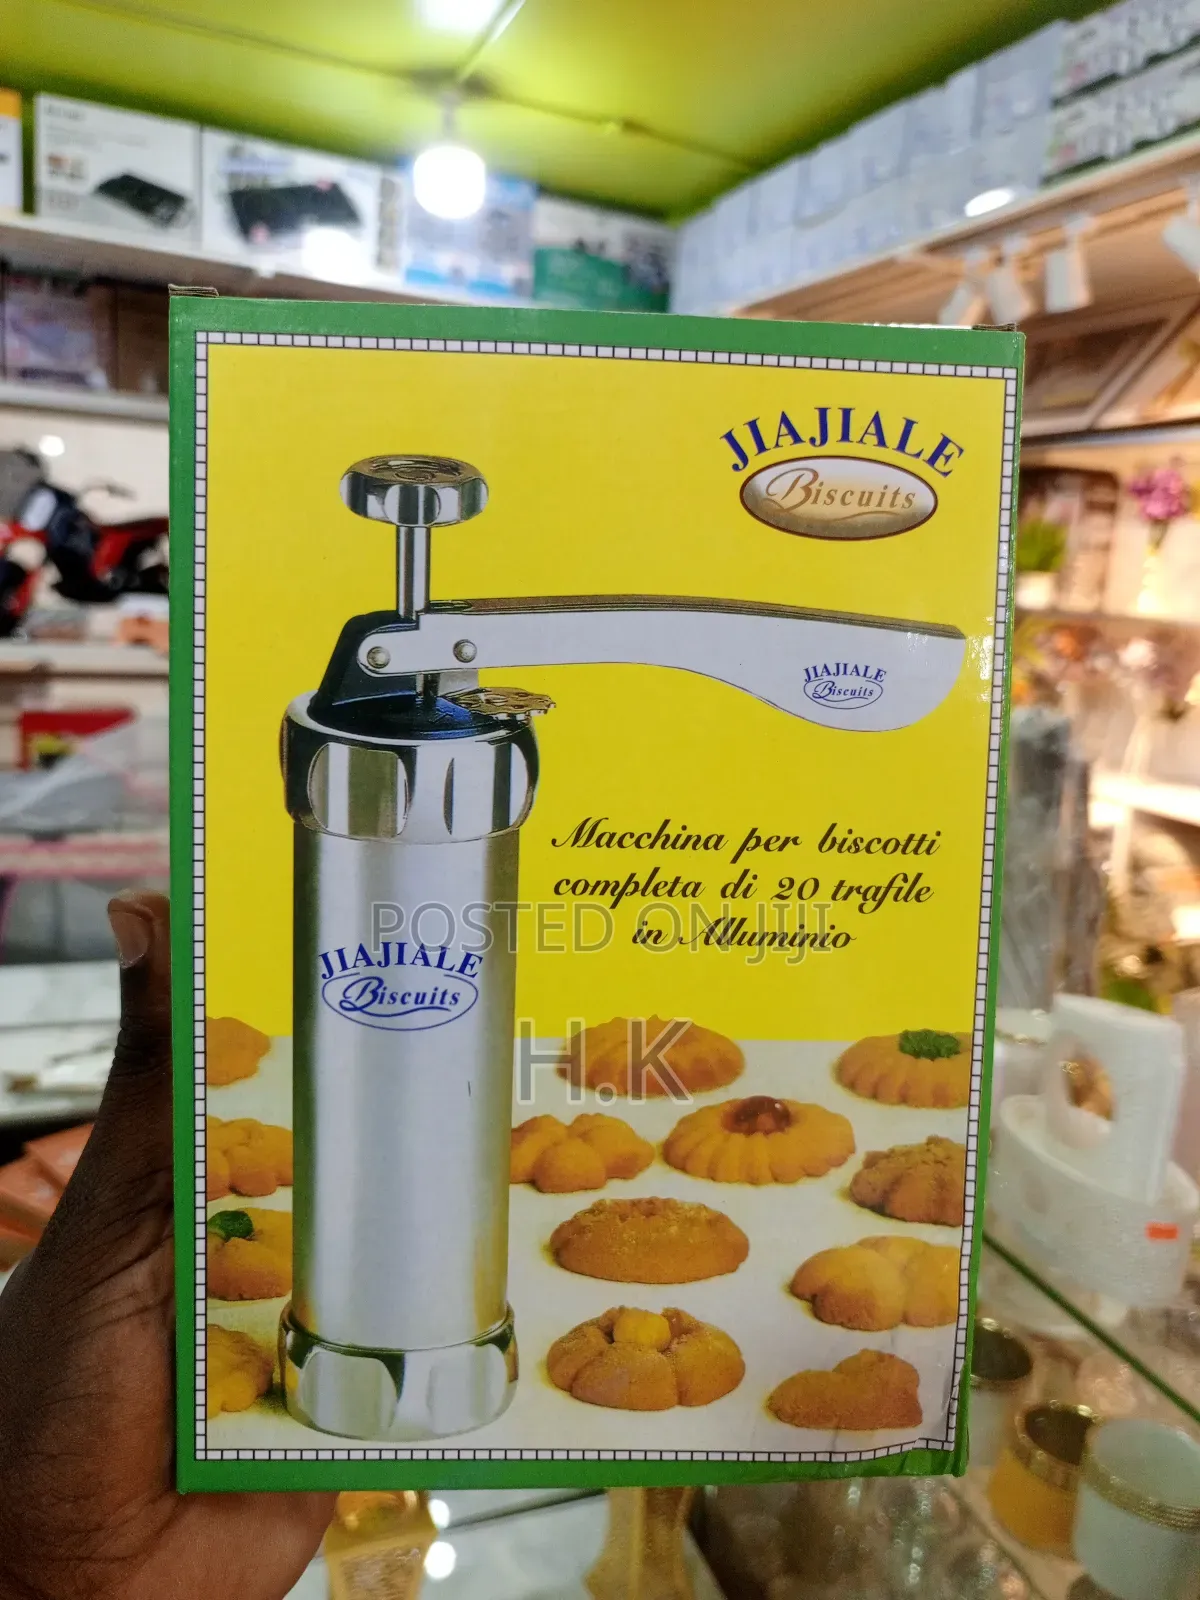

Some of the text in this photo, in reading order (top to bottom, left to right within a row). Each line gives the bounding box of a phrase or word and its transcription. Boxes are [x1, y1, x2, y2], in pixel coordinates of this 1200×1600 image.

[719, 406, 965, 478] JIAJIALE
[764, 467, 917, 522] Biscuits
[803, 662, 887, 683] JIAJIALE
[812, 680, 874, 702] Biscuits
[551, 816, 942, 864] Macchina per biscotti
[553, 867, 934, 915] completa di 20 trafile
[631, 916, 857, 950] in Alluminio
[318, 941, 483, 980] JIAJIALE
[339, 975, 461, 1018] Biscuits
